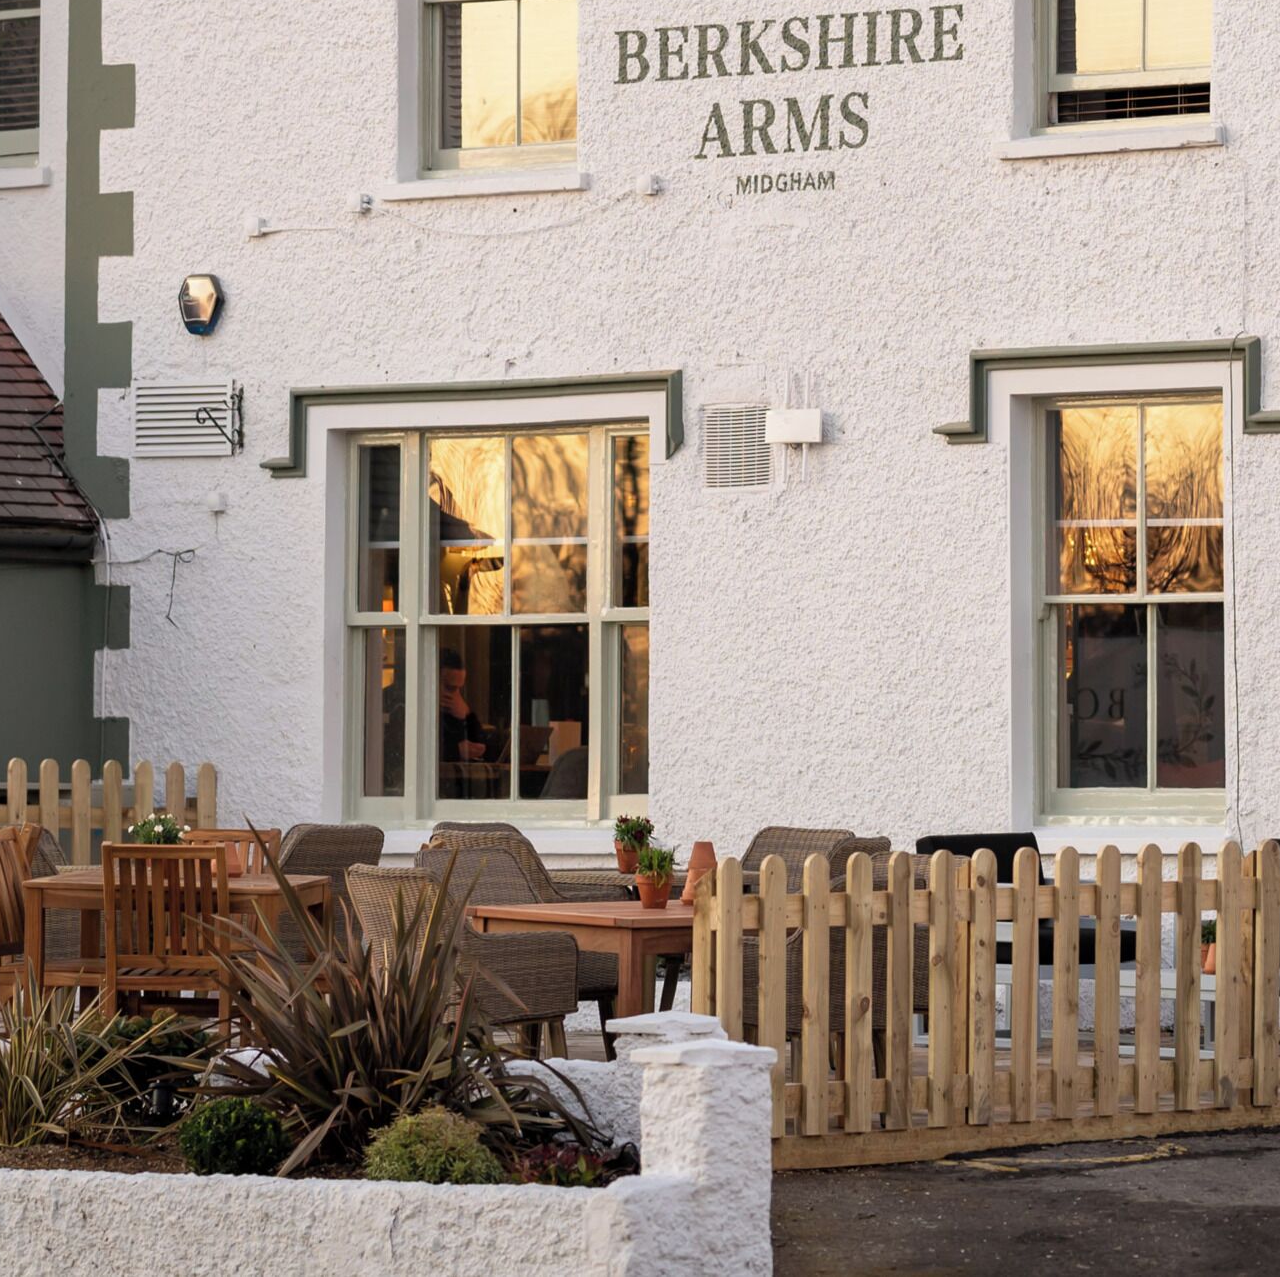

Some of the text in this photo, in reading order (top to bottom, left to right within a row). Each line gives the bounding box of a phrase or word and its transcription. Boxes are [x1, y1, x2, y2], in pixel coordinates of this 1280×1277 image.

[613, 4, 964, 85] BERKSHIRE
[694, 90, 869, 159] ARMS
[735, 170, 836, 196] MIDGHAM
